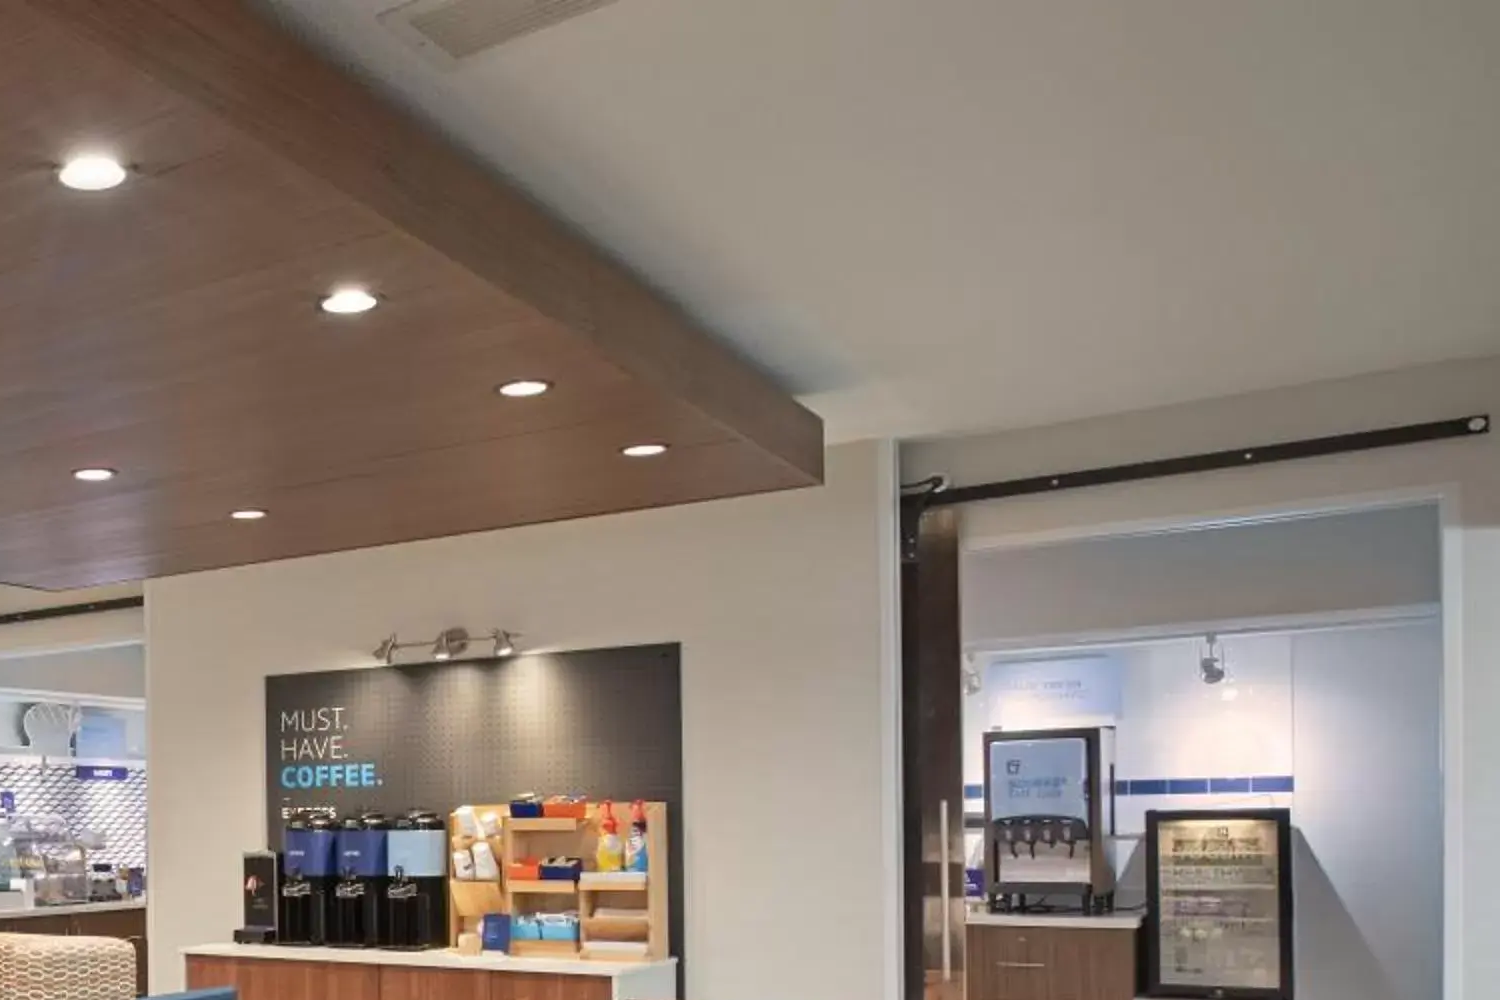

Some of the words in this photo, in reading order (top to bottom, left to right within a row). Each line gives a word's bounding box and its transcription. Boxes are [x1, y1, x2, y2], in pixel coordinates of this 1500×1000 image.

[281, 707, 349, 732] MUST.
[281, 735, 349, 760] HAVE.
[281, 763, 383, 789] COFFEE.
